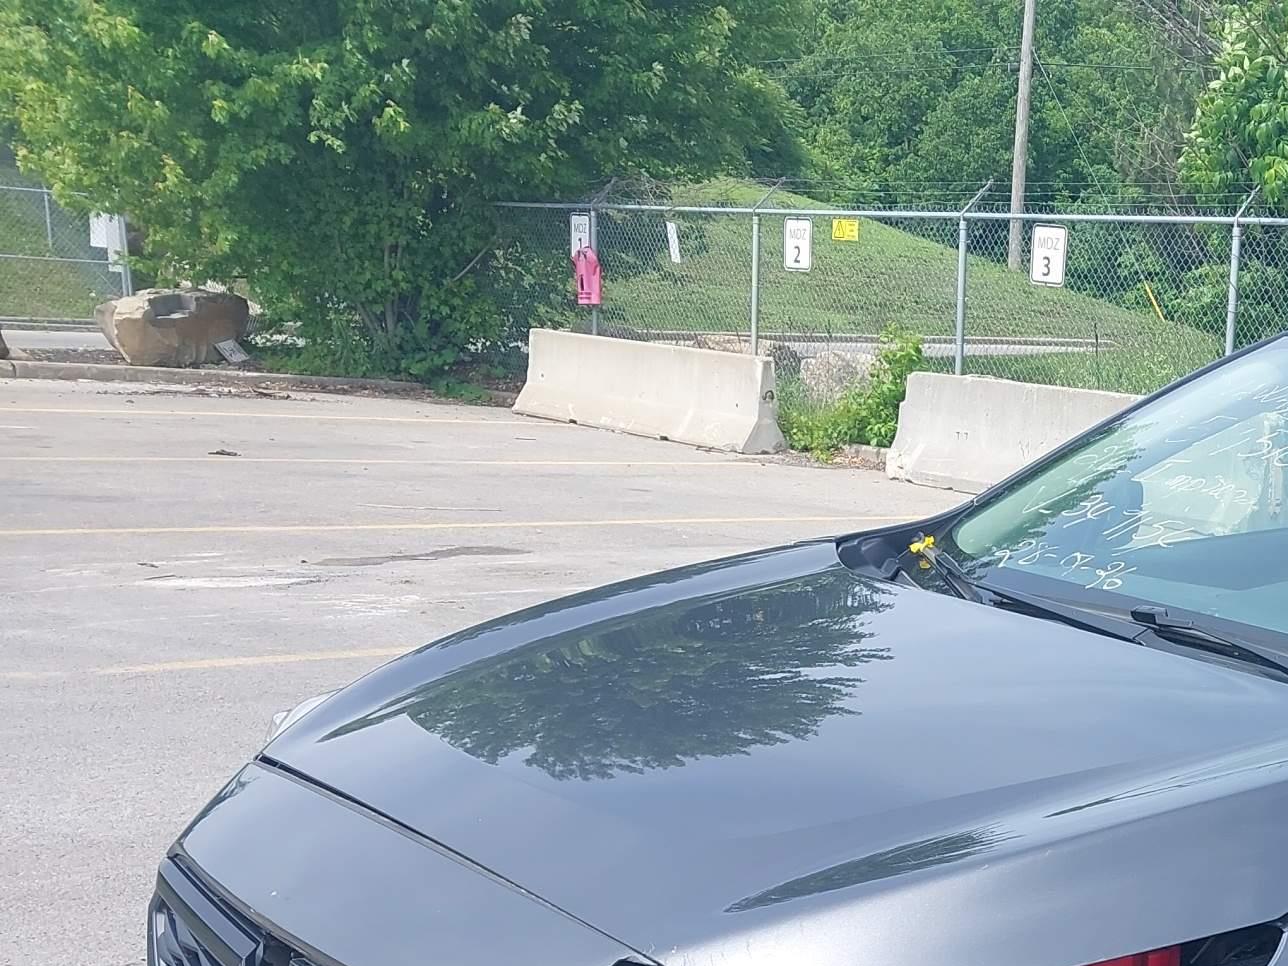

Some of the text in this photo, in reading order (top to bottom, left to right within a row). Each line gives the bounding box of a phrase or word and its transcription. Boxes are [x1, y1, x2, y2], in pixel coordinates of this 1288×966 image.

[573, 223, 587, 234] MDZ
[789, 228, 807, 241] MDZ
[1037, 236, 1061, 251] MDZ
[793, 246, 801, 264] 2
[1041, 255, 1051, 277] 3
